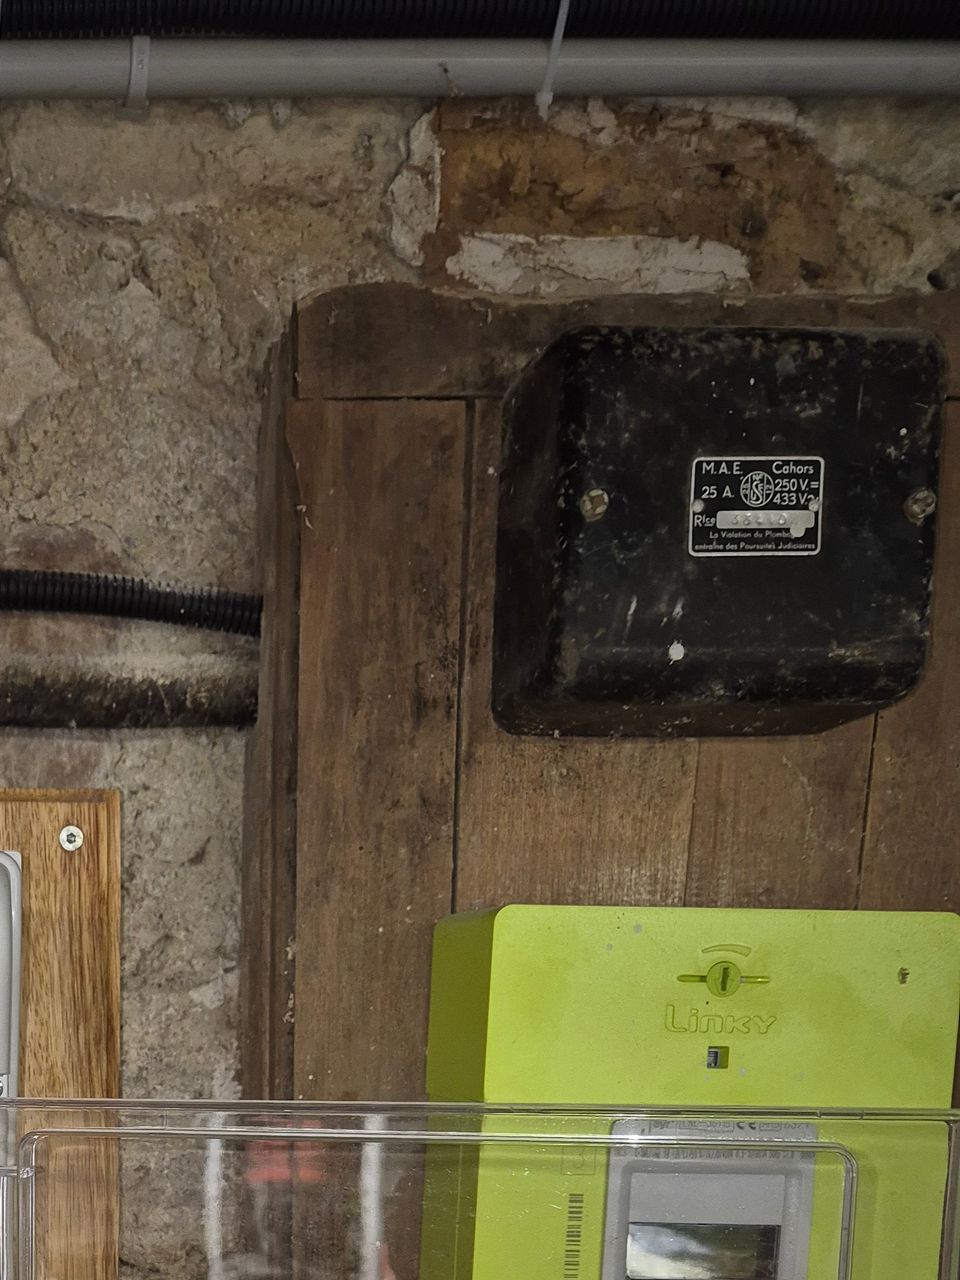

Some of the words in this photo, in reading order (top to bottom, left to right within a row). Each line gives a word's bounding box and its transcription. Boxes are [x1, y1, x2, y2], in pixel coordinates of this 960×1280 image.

[772, 461, 814, 474] Cahors
[775, 479, 797, 491] 250
[701, 486, 717, 498] 25
[773, 493, 796, 505] 433
[726, 541, 738, 550] des
[778, 541, 815, 550] Judiciaires
